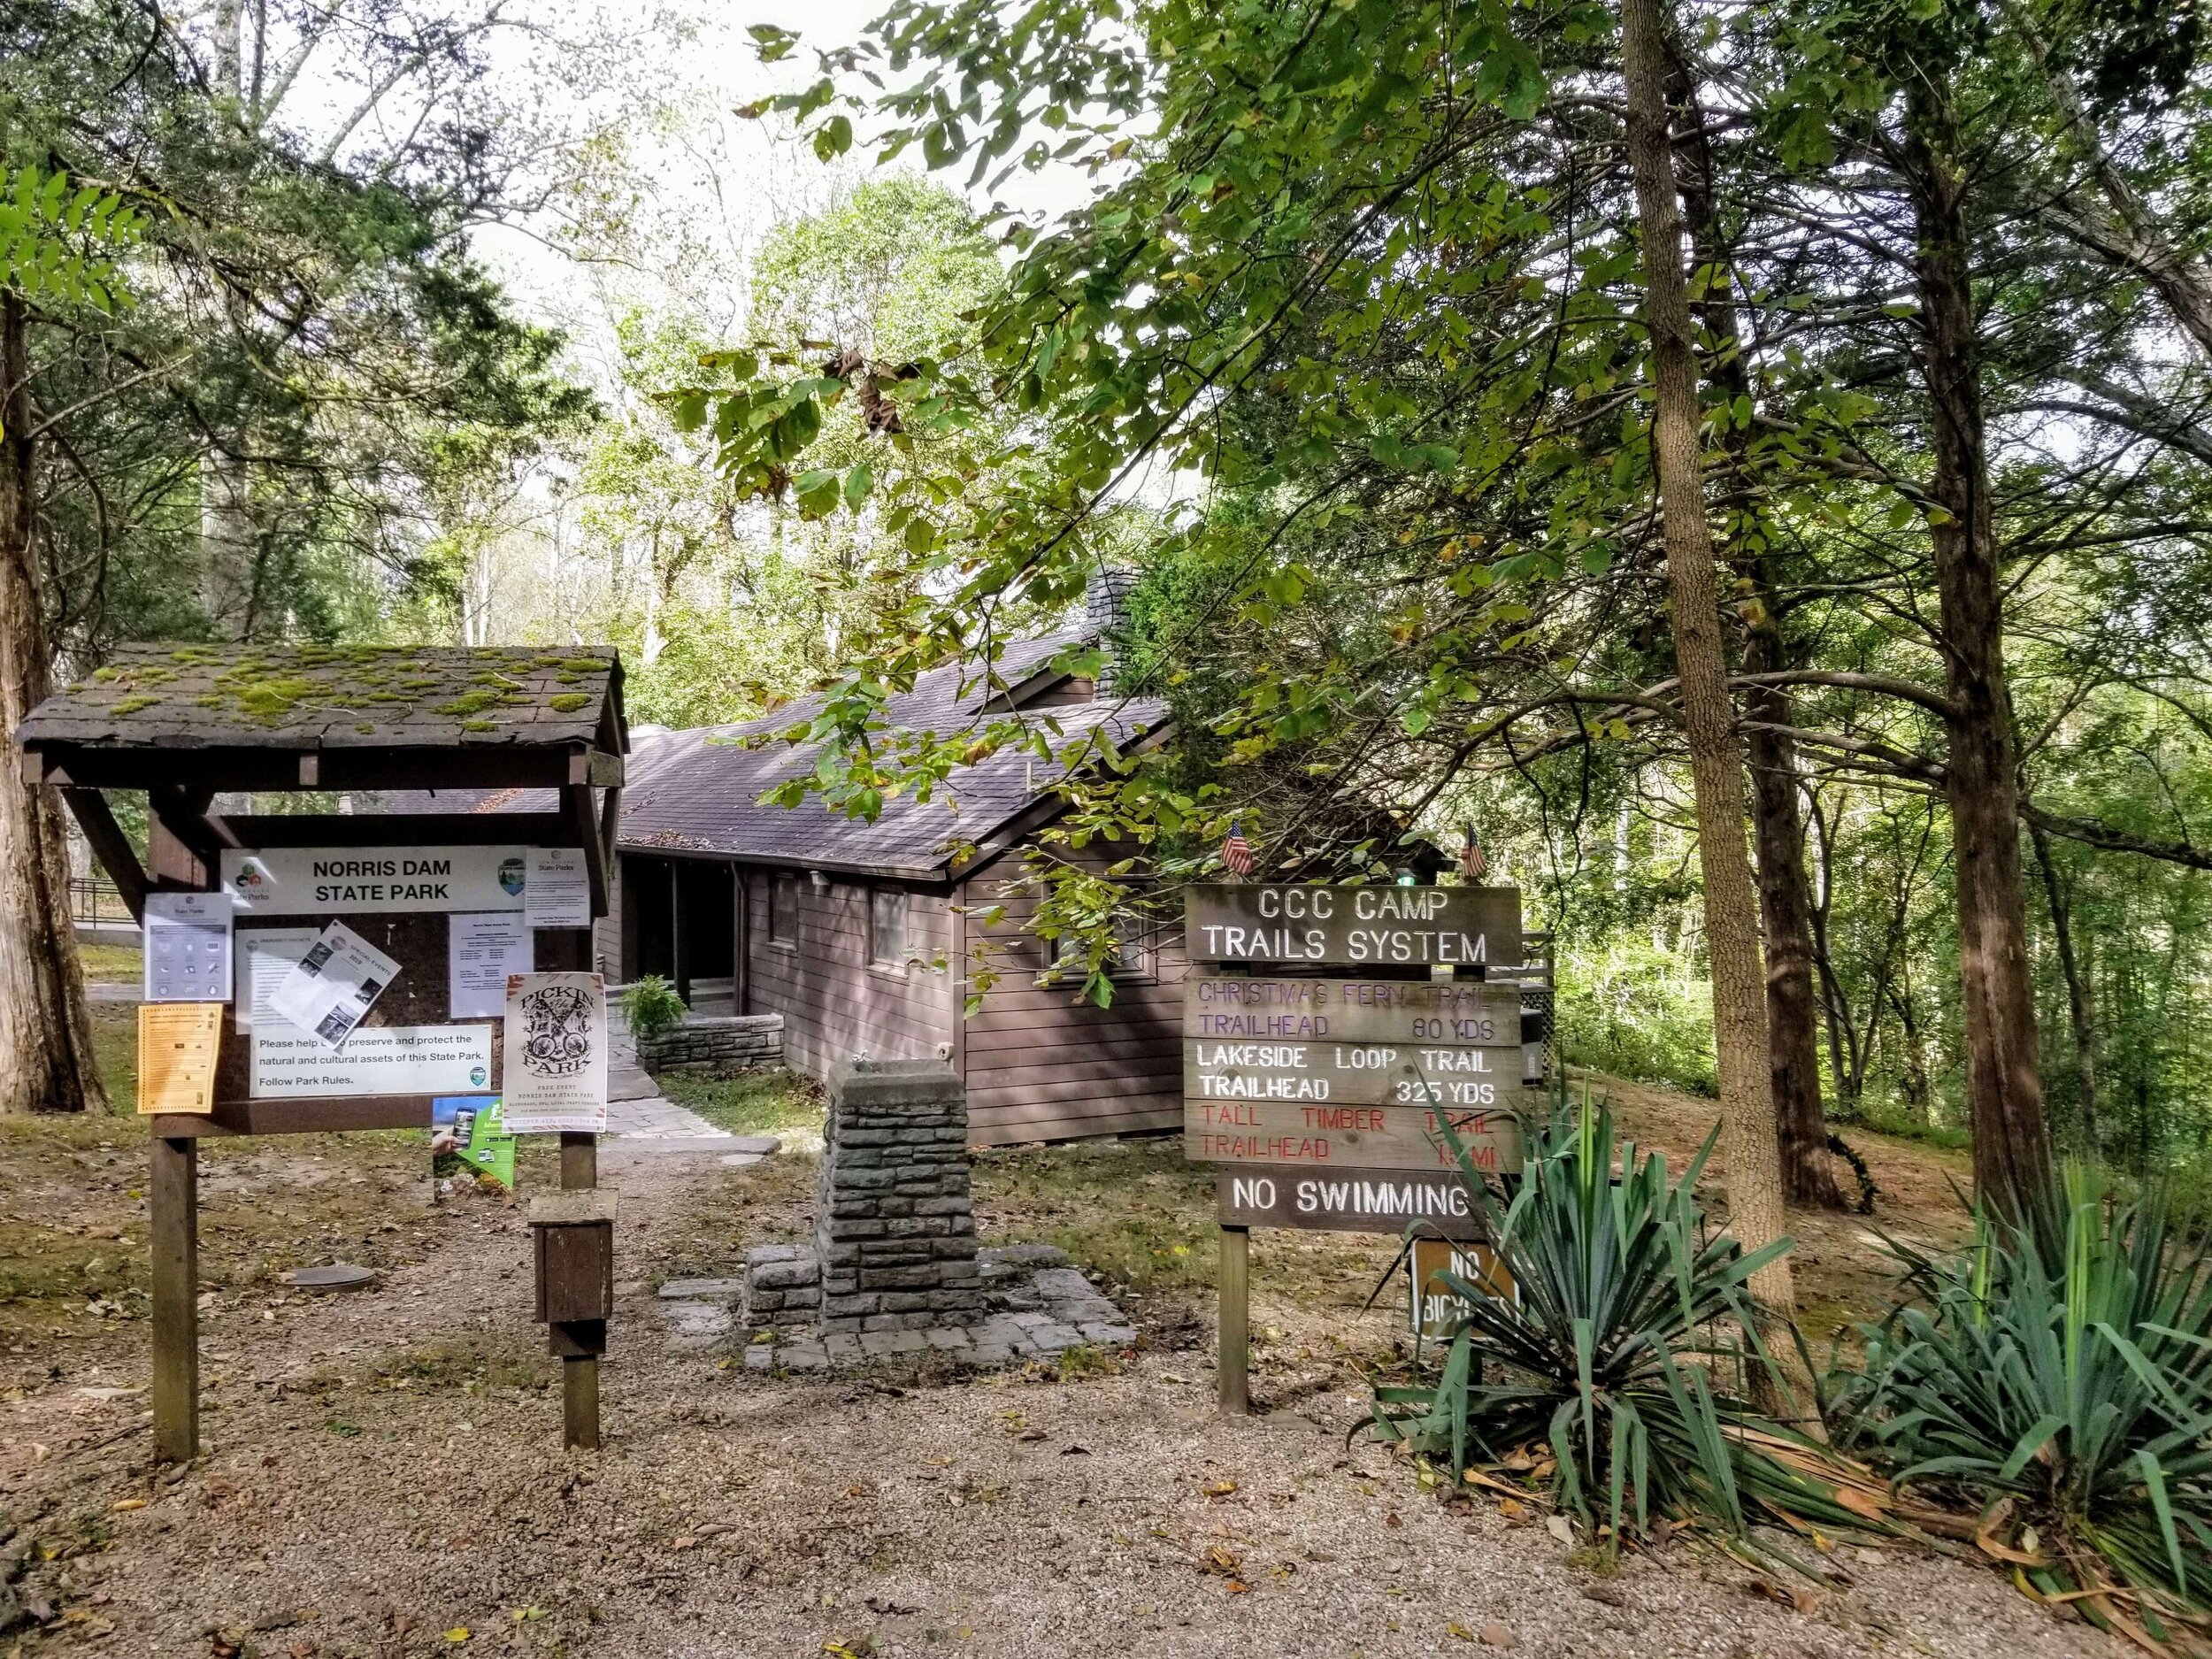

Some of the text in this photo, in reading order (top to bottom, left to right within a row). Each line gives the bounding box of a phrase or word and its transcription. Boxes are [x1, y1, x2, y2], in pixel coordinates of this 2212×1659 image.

[313, 859, 450, 877] NORRIS DAM
[315, 883, 449, 901] STATE PARK
[1258, 887, 1448, 921] CCC CAMP
[1201, 925, 1486, 963] TRAILS SYSTEM
[1198, 982, 1492, 1010] CHRISTMAS FERN TRAIL
[1198, 1014, 1494, 1041] TRAILHEAD 80 YDS
[259, 1040, 293, 1048] Please
[296, 1039, 318, 1048] help
[349, 1039, 393, 1048] preserve
[396, 1036, 414, 1045] and
[417, 1035, 453, 1046] protect
[259, 1051, 484, 1065] natural and cultural assets of this State Park.
[521, 1052, 593, 1074] PARK
[1196, 1044, 1493, 1072] LAKESIDE LOOP TRAIL
[259, 1076, 354, 1087] Follow Park Rules.
[1198, 1075, 1495, 1104] TRAILHEAD 325 YDS
[1201, 1105, 1263, 1126] TALL
[1301, 1107, 1386, 1133] TIMBER
[1201, 1134, 1330, 1159] TRAILHEAD
[1233, 1178, 1469, 1217] NO SWIMMING
[1450, 1251, 1480, 1279] NO
